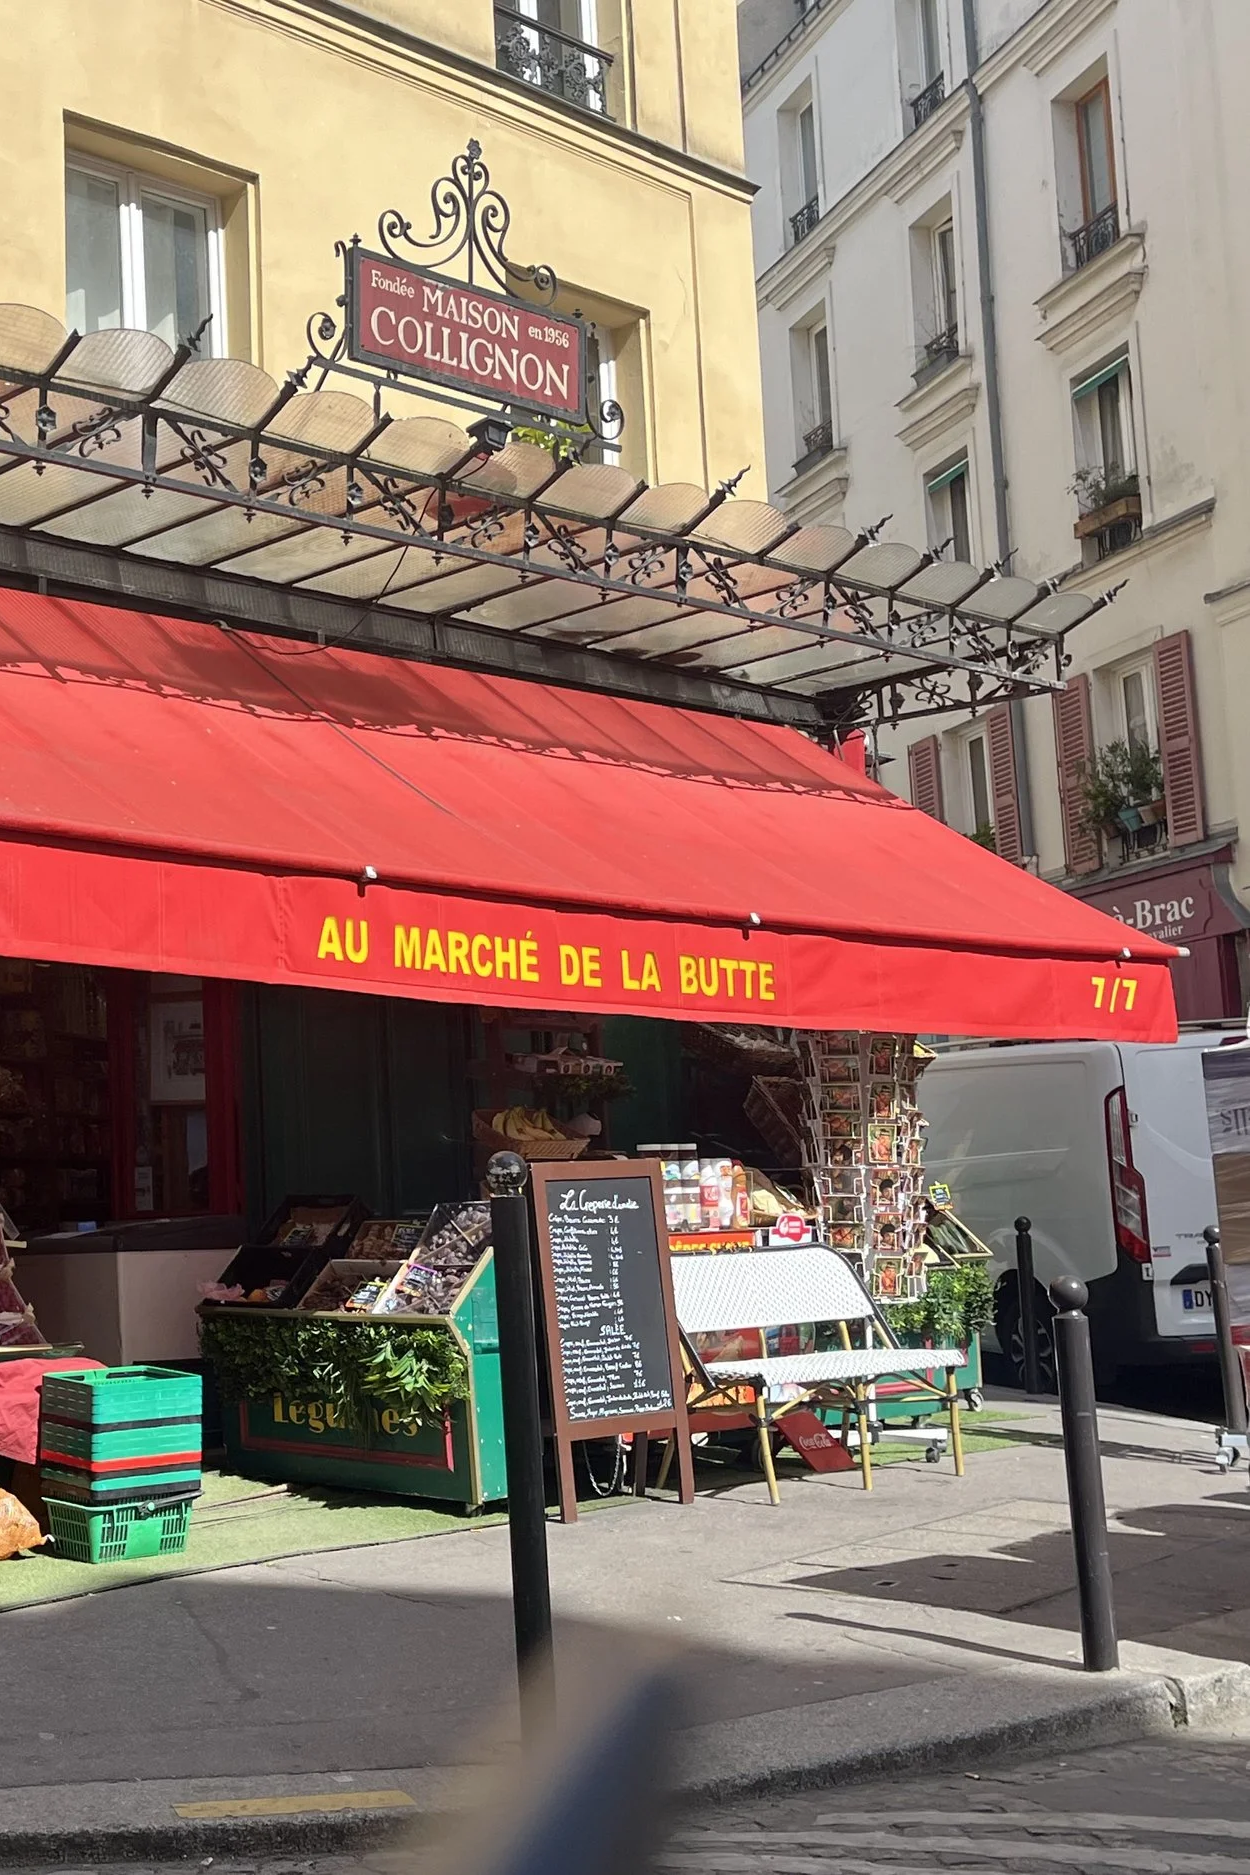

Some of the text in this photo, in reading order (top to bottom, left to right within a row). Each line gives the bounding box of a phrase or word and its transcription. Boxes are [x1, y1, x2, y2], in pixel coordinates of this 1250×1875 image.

[371, 269, 570, 349] Fondée MAISON en 1956
[370, 306, 570, 401] COLLIGNON
[317, 916, 776, 1001] AU MARCHÉ DE LA BUTTE
[1091, 976, 1138, 1014] 7/7
